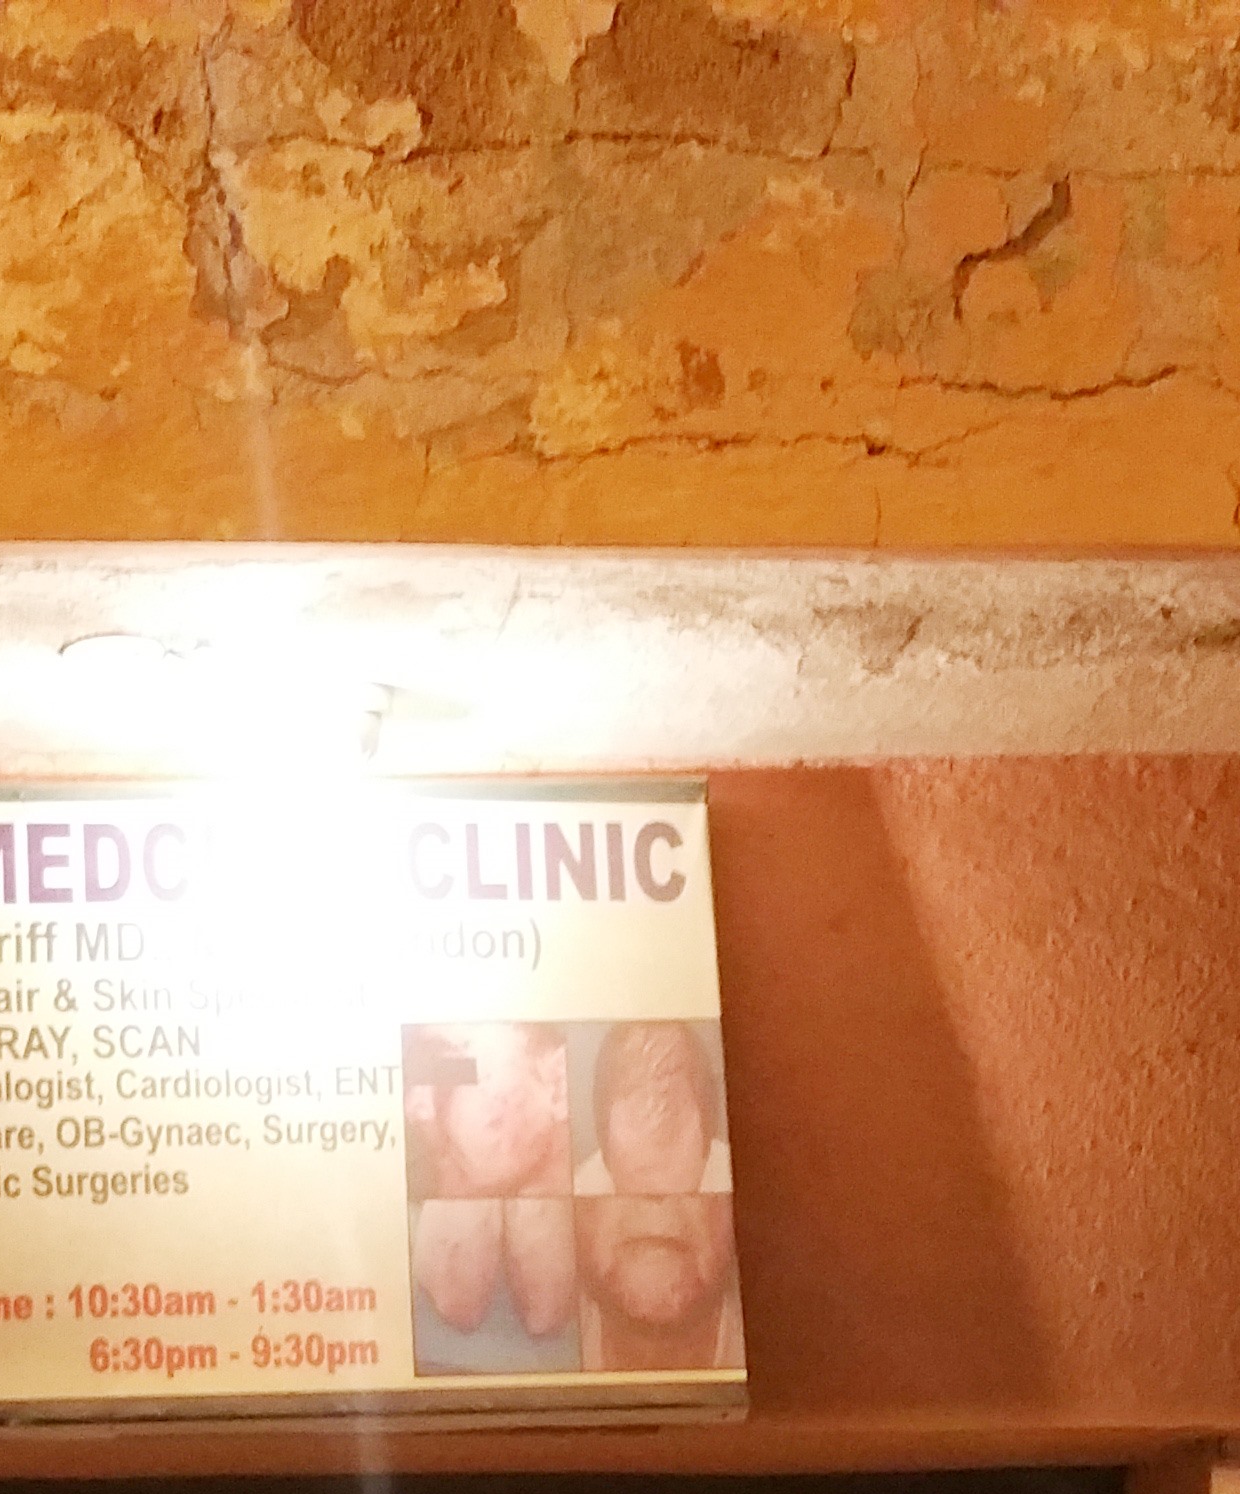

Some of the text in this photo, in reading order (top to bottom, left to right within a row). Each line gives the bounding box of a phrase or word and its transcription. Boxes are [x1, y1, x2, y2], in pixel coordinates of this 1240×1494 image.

[406, 820, 687, 904] CLINIC
[53, 978, 79, 1013] &
[93, 978, 172, 1013] Skin
[92, 1024, 201, 1059] SCAN
[115, 1067, 323, 1105] Cardiologist,
[334, 1065, 401, 1097] ENT
[56, 1115, 252, 1155] OB-Gynaec,
[262, 1113, 397, 1152] Surgery,
[32, 1164, 191, 1204] Surgeries
[68, 1282, 217, 1319] 10:30am
[251, 1279, 377, 1314] 1:30am
[89, 1336, 218, 1378] 6:30pm
[251, 1332, 379, 1374] 9:30pm
